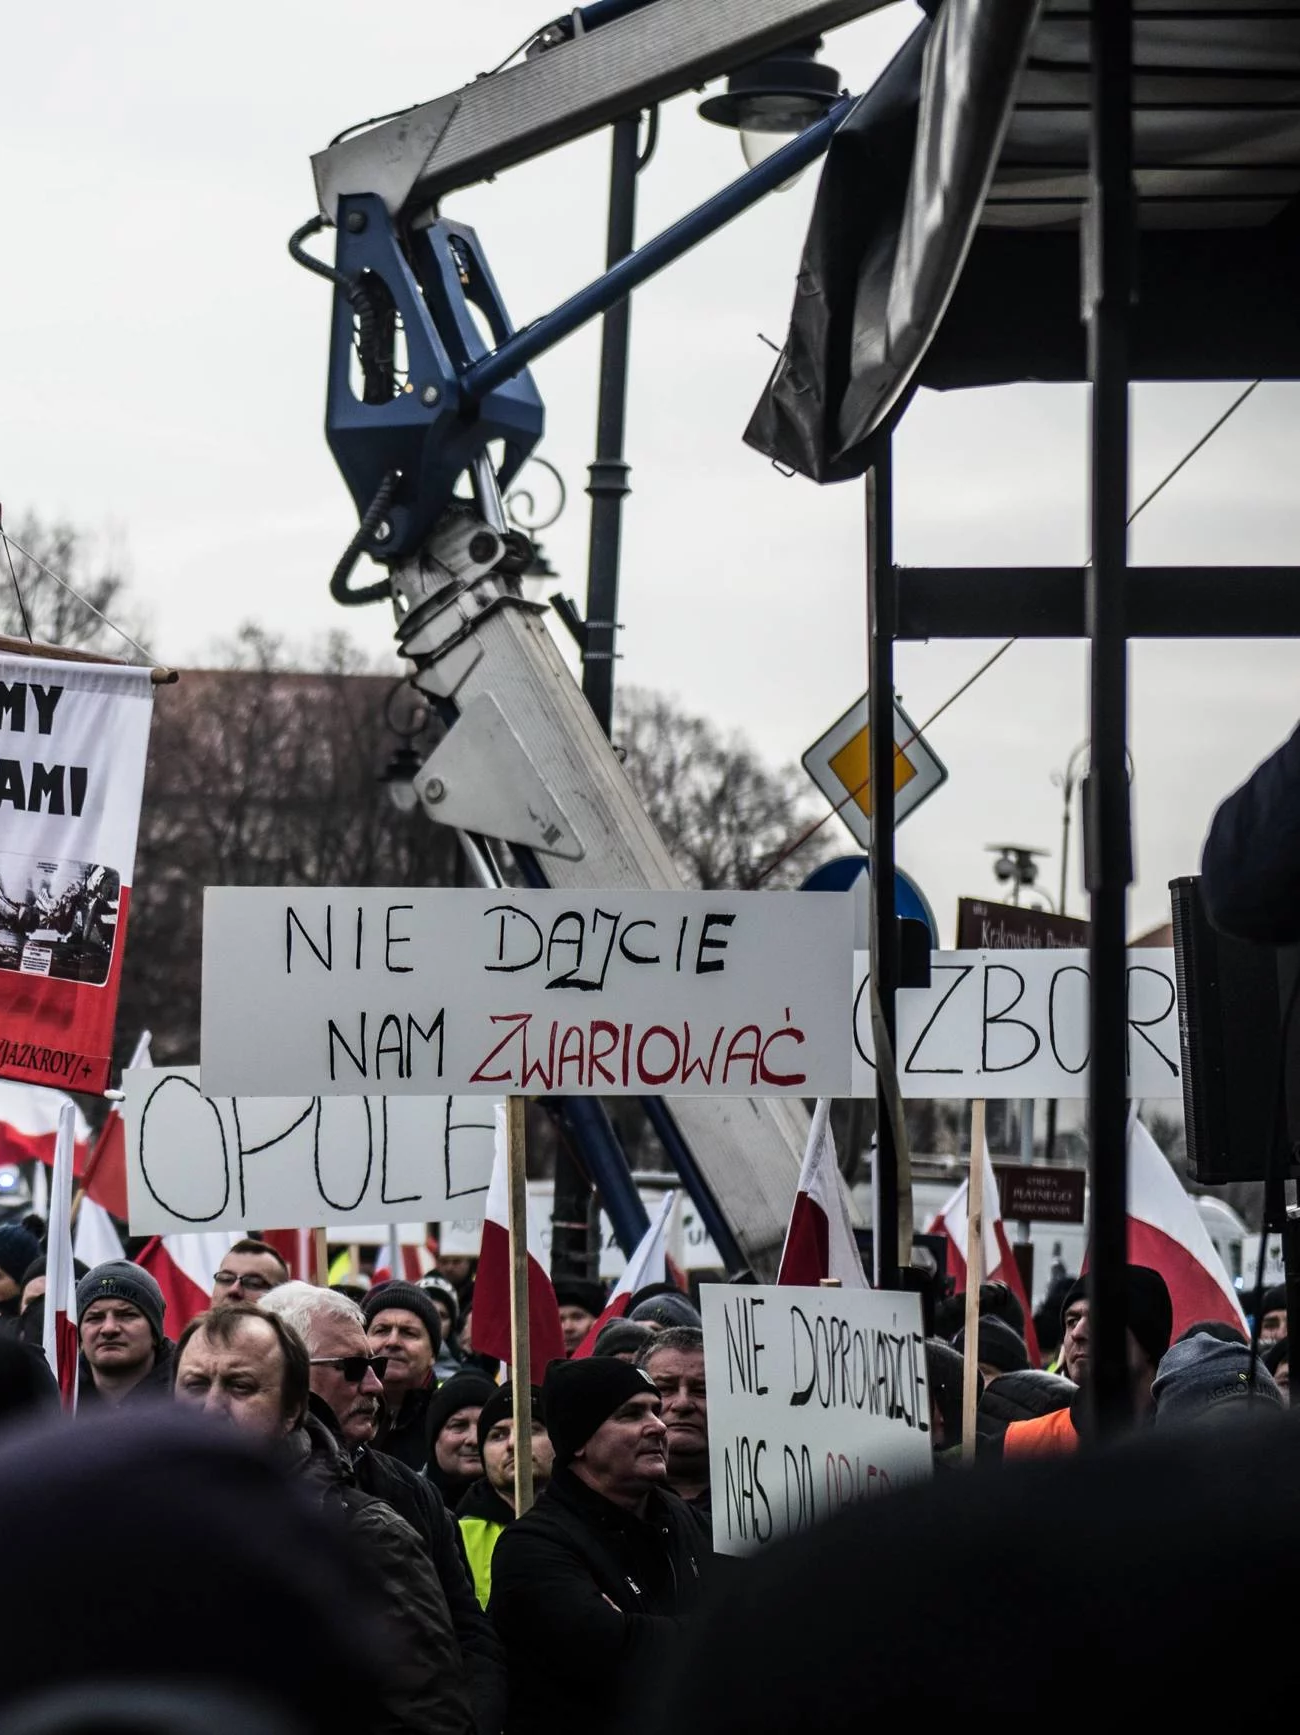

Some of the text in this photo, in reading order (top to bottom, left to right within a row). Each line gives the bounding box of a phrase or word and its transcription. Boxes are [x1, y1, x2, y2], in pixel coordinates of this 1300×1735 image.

[286, 903, 736, 992] NIE DAJCIE
[328, 1007, 808, 1091] NAM ZWARIOWAĆ
[724, 1297, 769, 1396] NIE
[724, 1435, 773, 1545] NAS
